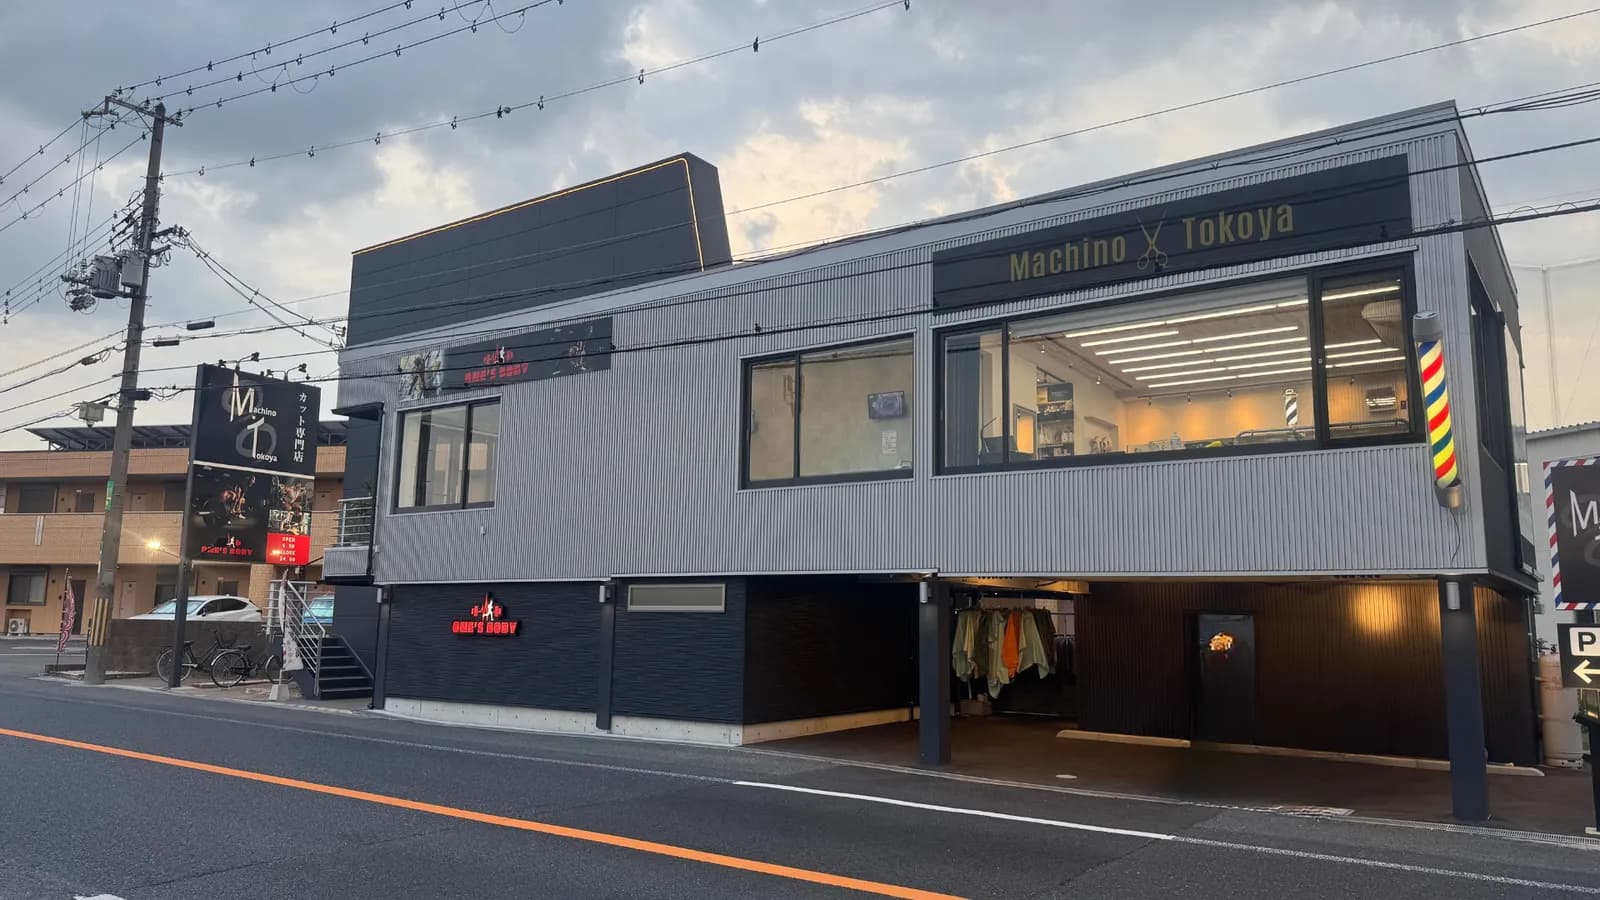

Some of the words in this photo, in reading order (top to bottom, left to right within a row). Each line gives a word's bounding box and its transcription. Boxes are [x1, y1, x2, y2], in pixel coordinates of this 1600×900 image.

[1009, 235, 1127, 282] Machino
[1182, 203, 1295, 249] Tokoya
[246, 416, 278, 463] Tokoya
[293, 392, 307, 463] カット専門店
[452, 621, 484, 633] ONE'S
[486, 621, 517, 634] BODY
[1578, 632, 1596, 651] P
